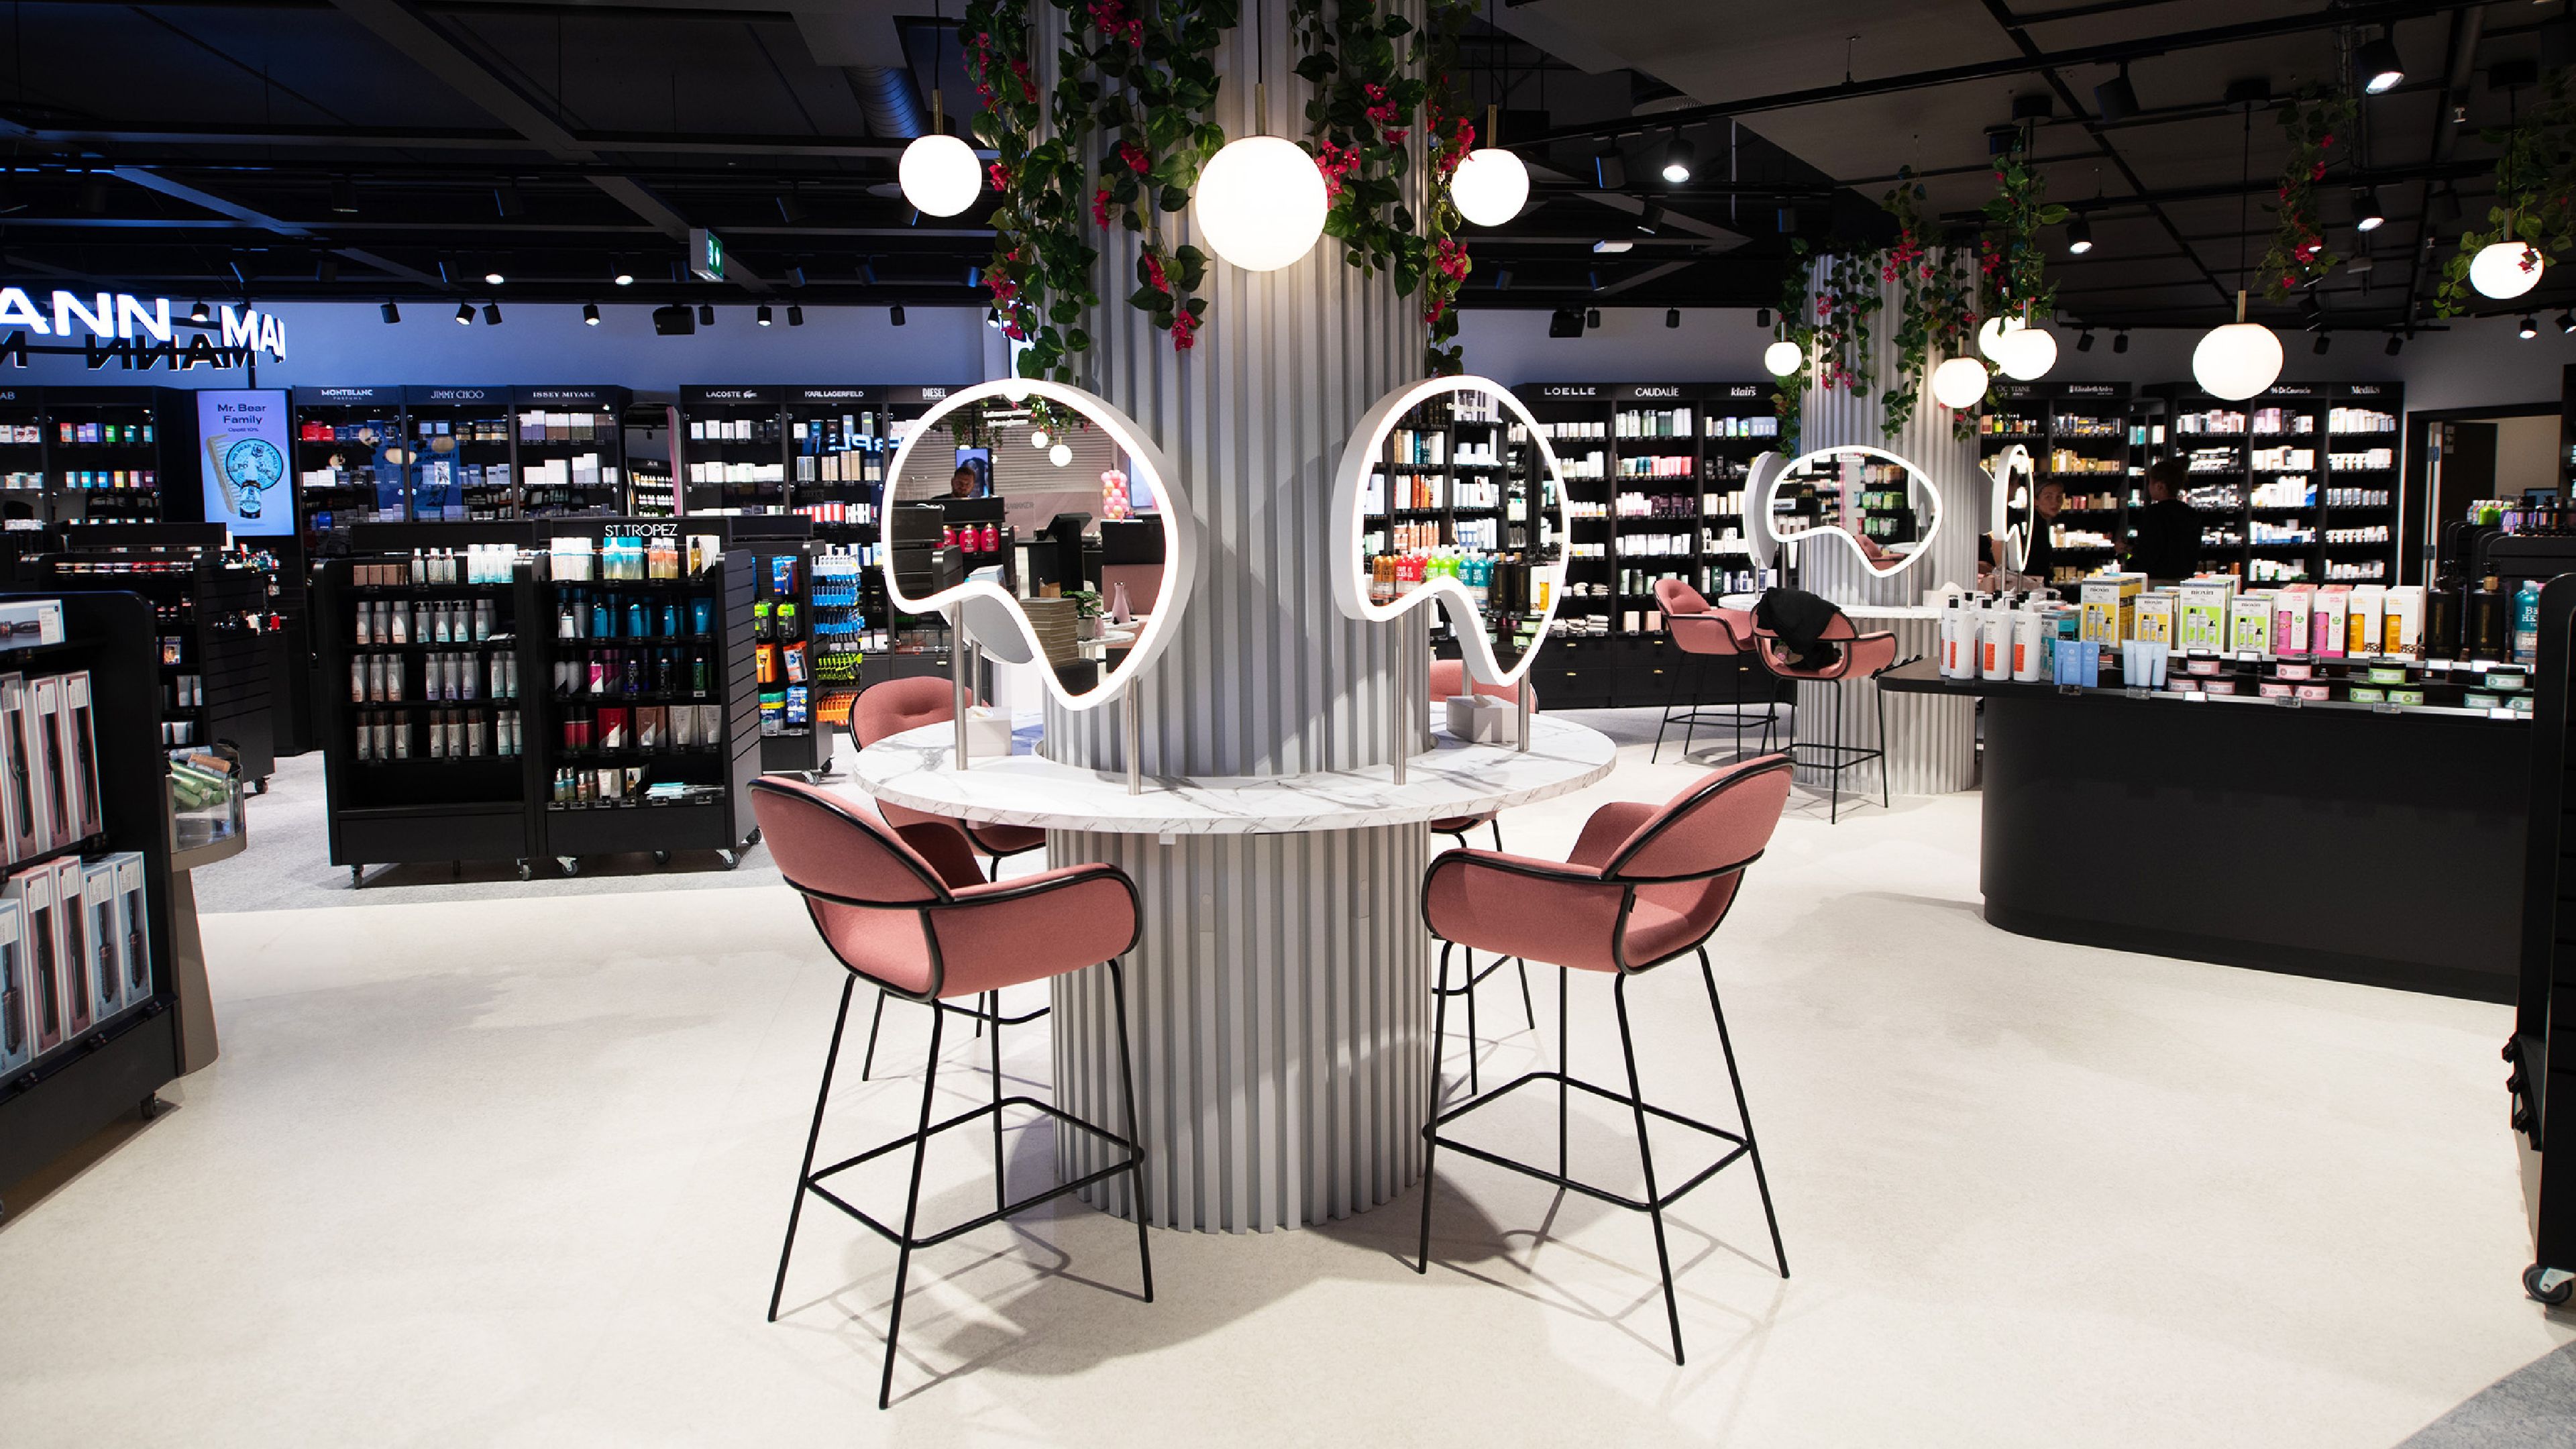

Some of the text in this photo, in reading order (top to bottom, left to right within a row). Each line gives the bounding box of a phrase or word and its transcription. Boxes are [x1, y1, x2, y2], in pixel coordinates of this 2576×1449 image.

[430, 390, 484, 399] JIMMY CHOO
[922, 387, 947, 398] DIESEL
[1730, 386, 1757, 397] klairs
[217, 403, 267, 412] Mr. Bear
[223, 415, 262, 425] Family
[605, 523, 678, 537] ST.TROPEZ
